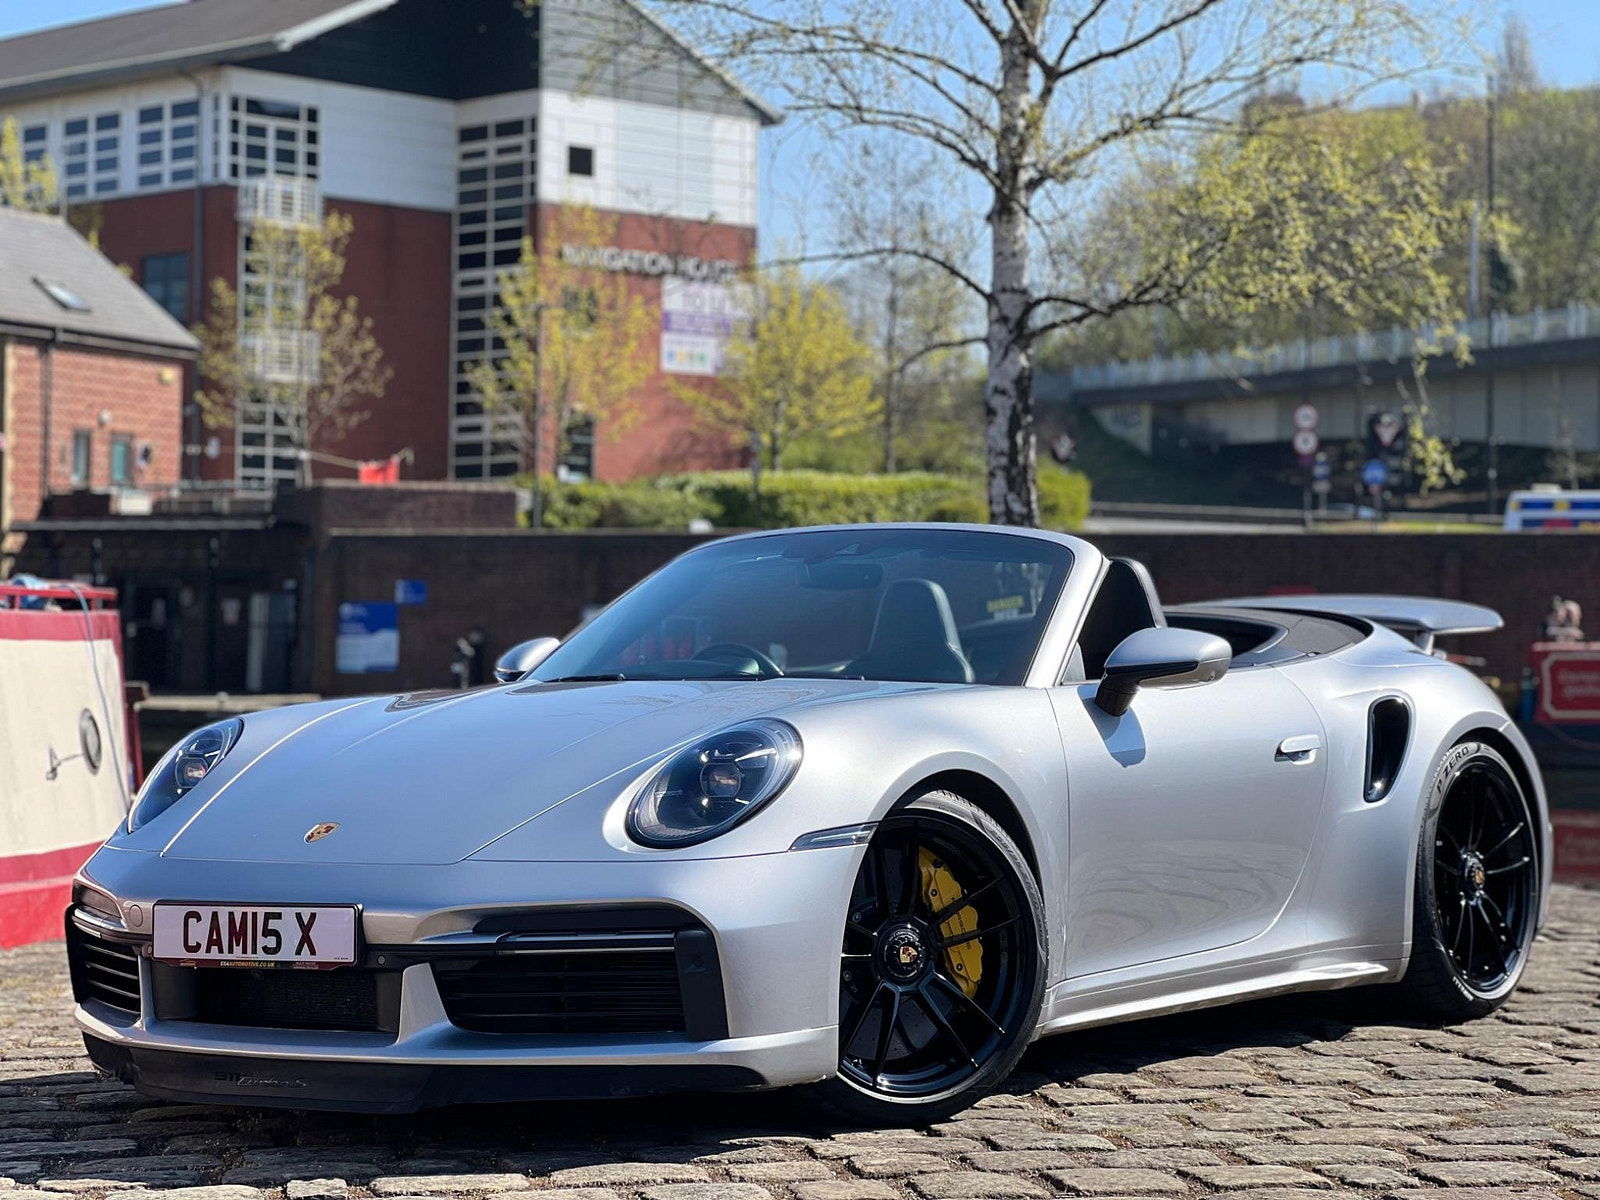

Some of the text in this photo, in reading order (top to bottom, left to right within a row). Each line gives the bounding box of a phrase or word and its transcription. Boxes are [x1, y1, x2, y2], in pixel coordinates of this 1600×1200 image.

[1436, 746, 1469, 794] P ZERO
[295, 912, 317, 956] X
